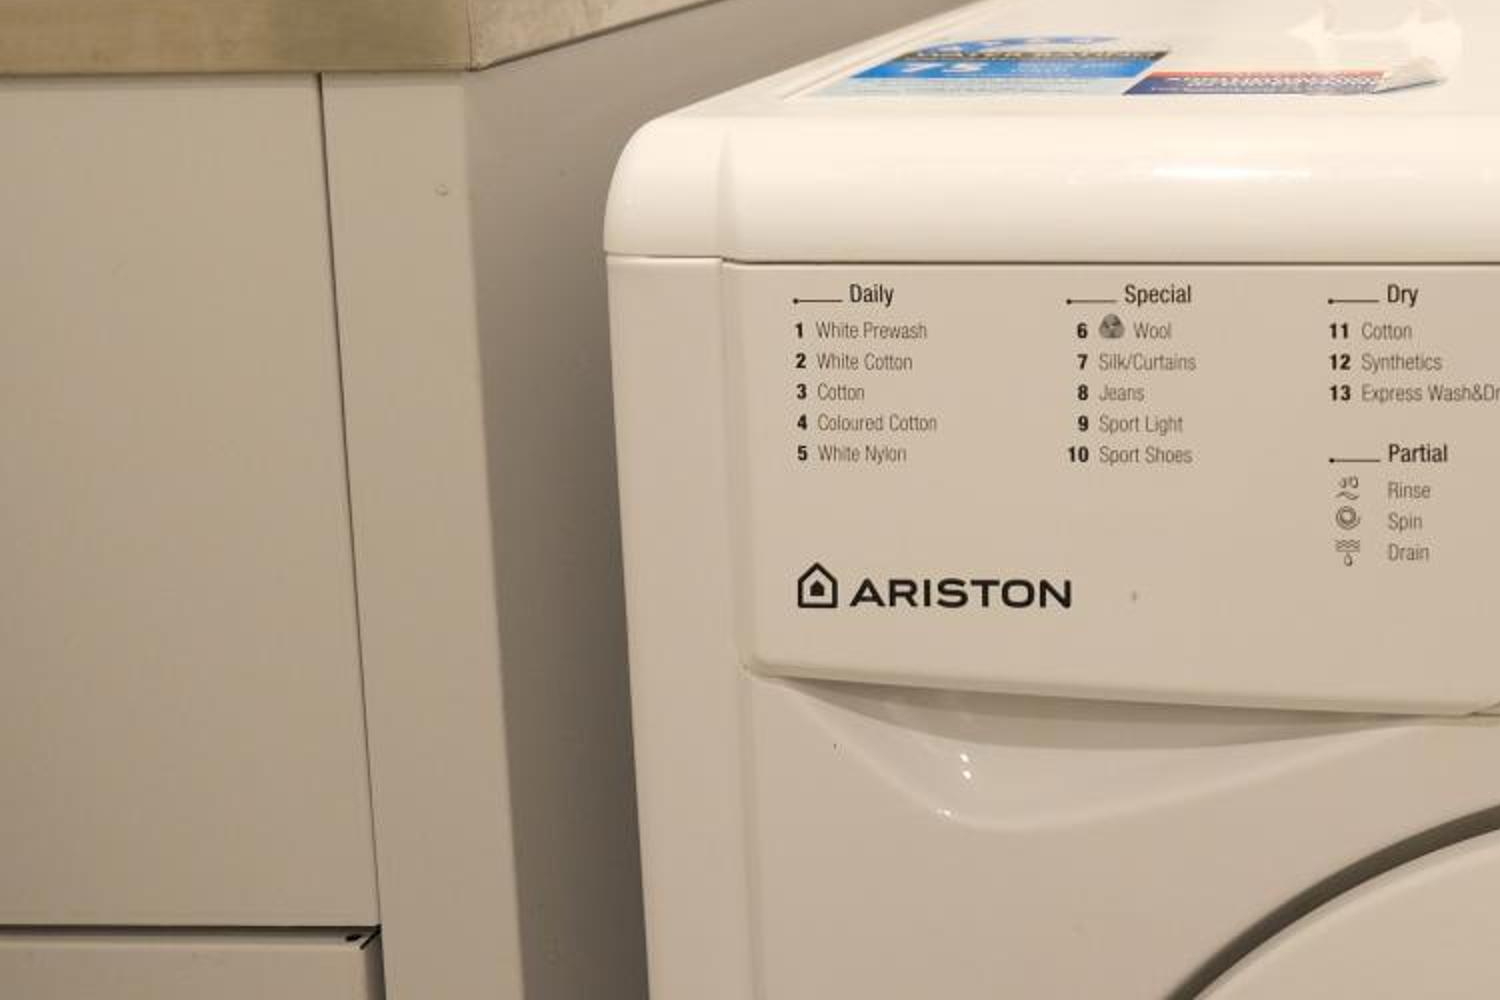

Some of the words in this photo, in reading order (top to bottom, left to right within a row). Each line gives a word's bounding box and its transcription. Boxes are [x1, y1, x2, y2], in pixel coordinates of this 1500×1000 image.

[850, 284, 894, 308] Daily
[1125, 284, 1191, 307] Special
[1388, 284, 1418, 308] Dry
[796, 323, 803, 338] 1
[816, 322, 858, 339] White
[863, 322, 927, 339] Prewash
[1077, 323, 1088, 338] 6
[1134, 322, 1171, 339] Wool
[1330, 323, 1348, 339] 11
[1362, 322, 1412, 340] Cotton
[796, 353, 806, 368] 2
[816, 353, 858, 370] White
[864, 352, 912, 371] Cotton
[1078, 354, 1088, 370] 7
[1099, 353, 1196, 371] Silk/Curtains
[1331, 354, 1350, 370] 12
[1362, 353, 1442, 374] Synthetics
[797, 384, 807, 399] 3
[818, 382, 864, 401] Cotton
[1078, 384, 1088, 400] 8
[1099, 384, 1144, 402] Jeans
[1330, 385, 1350, 401] 13
[1362, 384, 1422, 404] Express
[797, 415, 807, 430] 4
[818, 413, 884, 431] Coloured
[890, 414, 936, 432] Cotton
[1078, 416, 1088, 432] 9
[1099, 413, 1139, 435] Sport
[1145, 416, 1183, 436] Light
[798, 445, 808, 461] 5
[818, 445, 860, 462] White
[865, 445, 906, 465] Nylon
[1069, 446, 1089, 462] 10
[1100, 445, 1139, 466] Sport
[1145, 445, 1193, 464] Shoes
[1389, 444, 1447, 462] Partial
[1388, 481, 1430, 499] Rinse
[1388, 512, 1422, 533] Spin
[1388, 543, 1429, 561] Drain
[850, 578, 1071, 608] ARISTON
